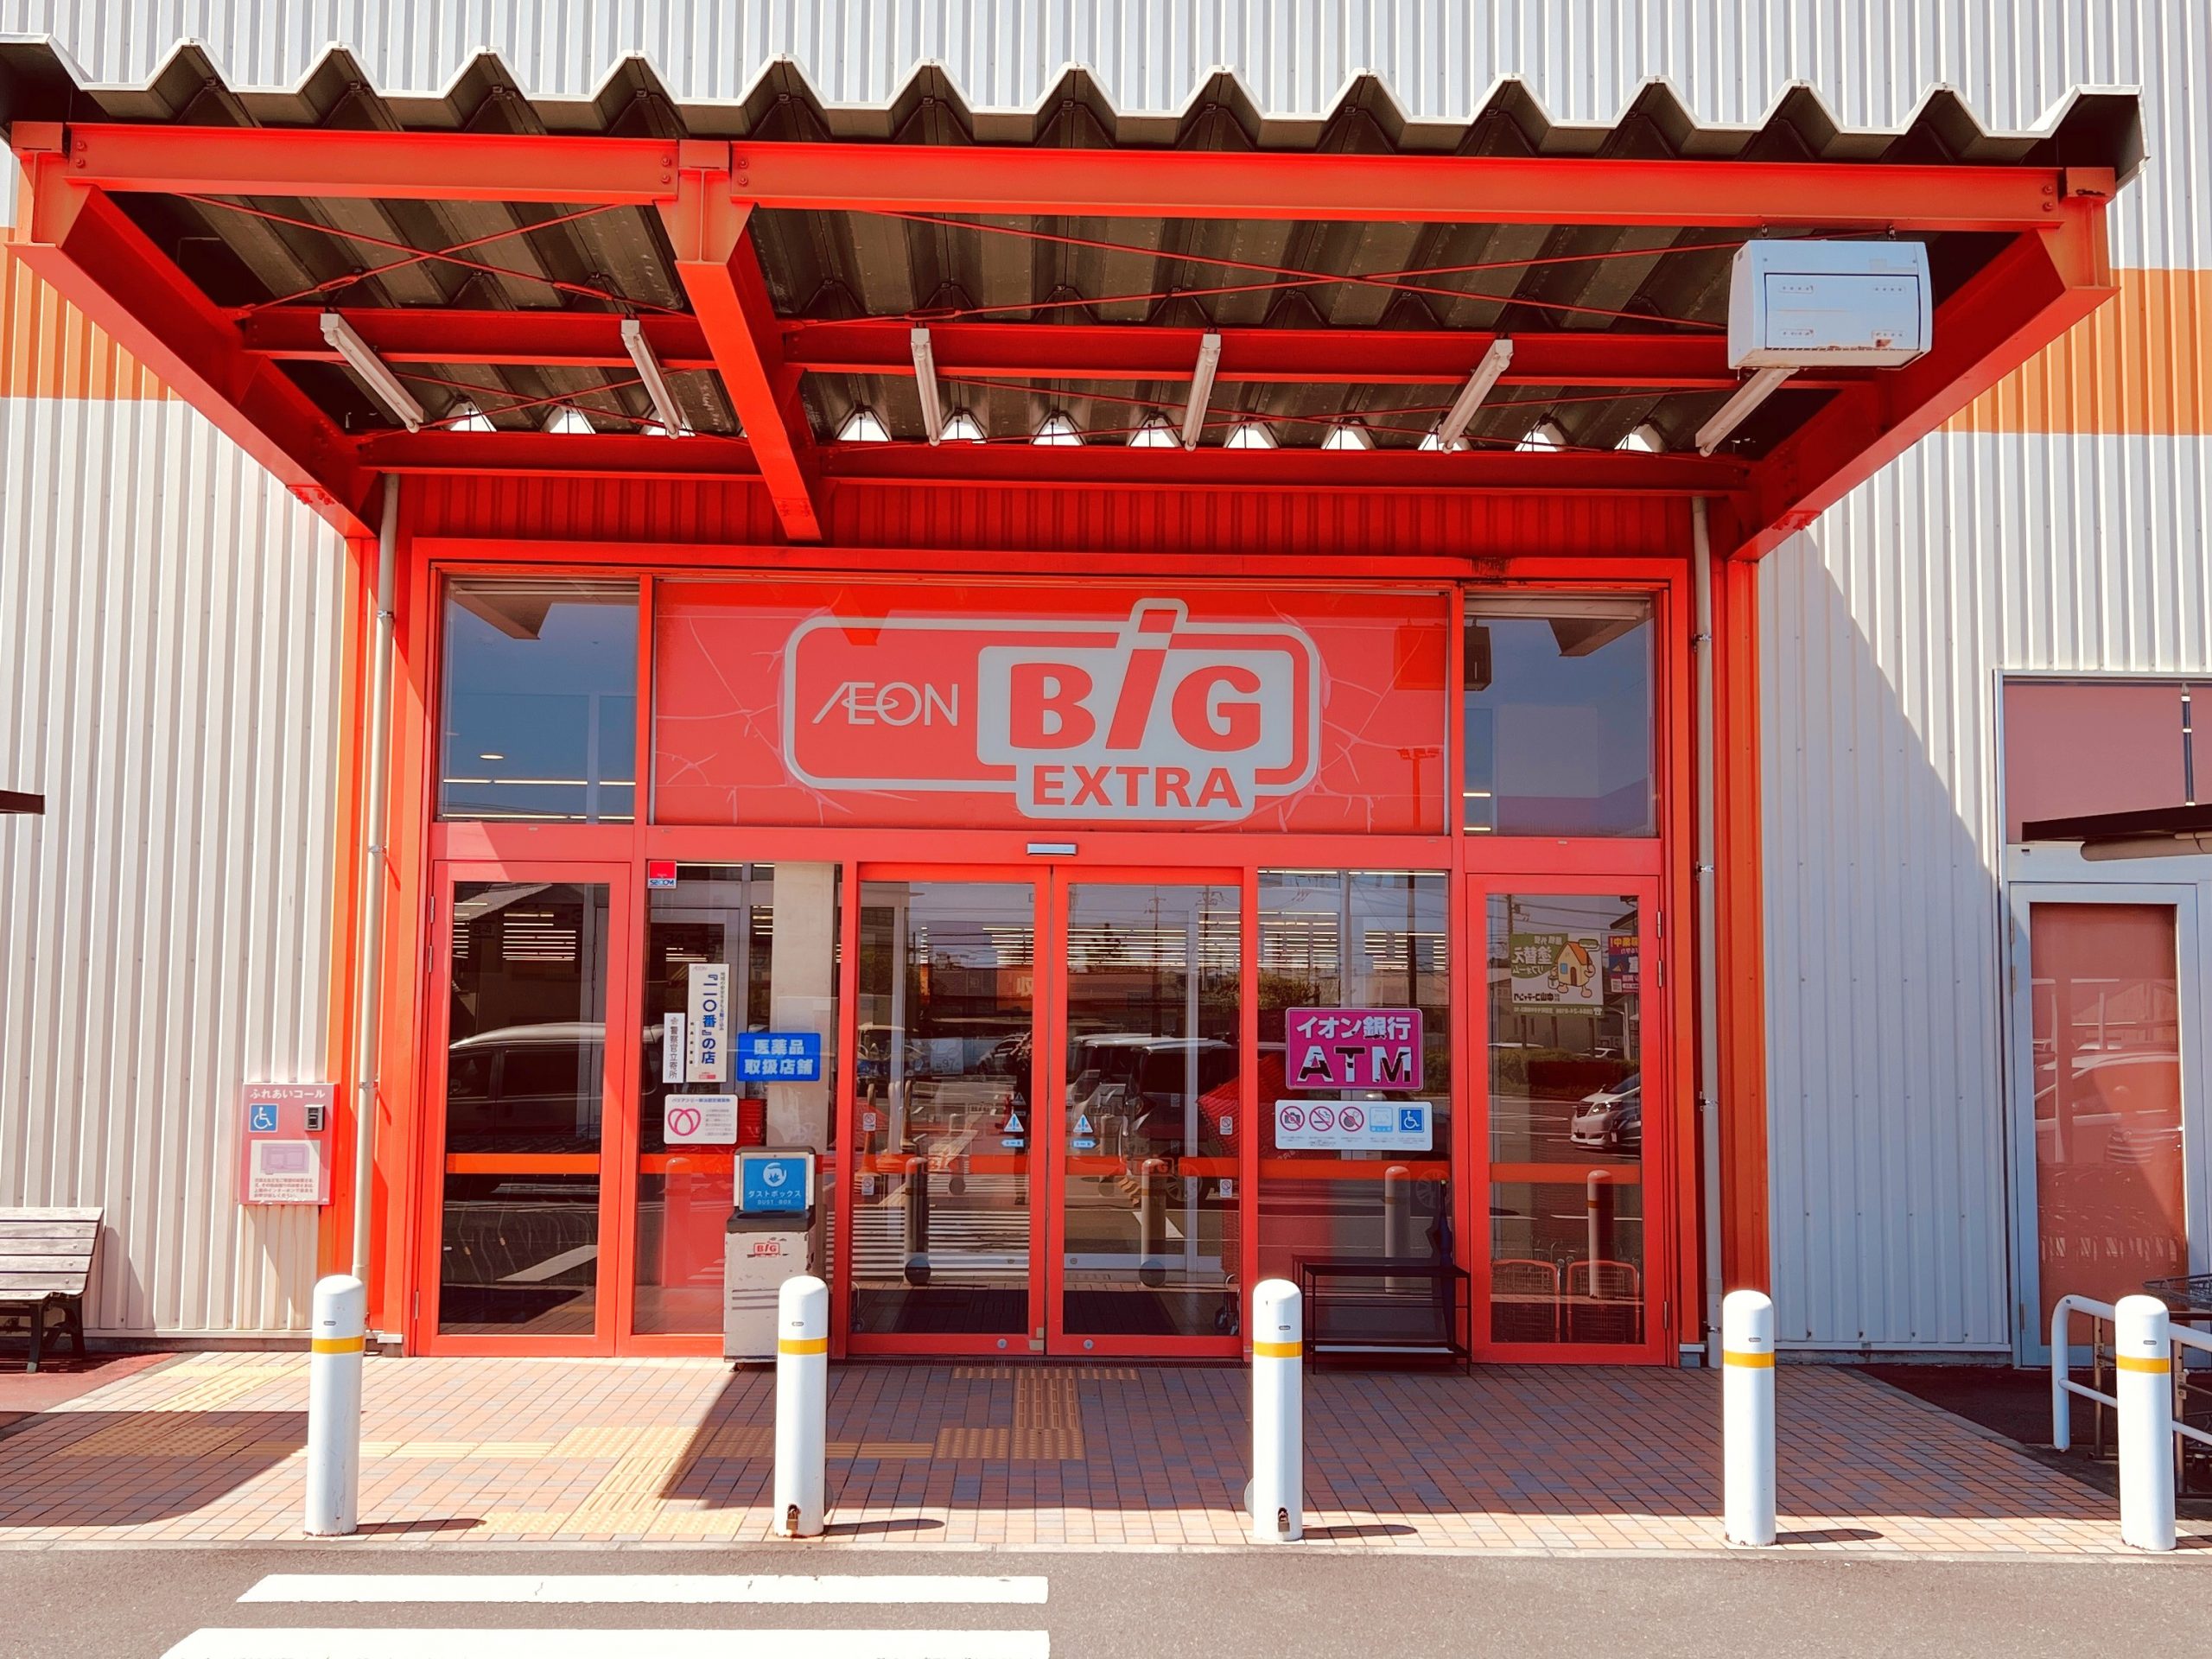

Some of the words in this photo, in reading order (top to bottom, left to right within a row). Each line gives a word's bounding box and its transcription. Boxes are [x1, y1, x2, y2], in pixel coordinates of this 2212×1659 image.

[1033, 766, 1243, 808] EXTRA
[1297, 1015, 1411, 1040] イオン銀行
[753, 1039, 805, 1056] 医薬品
[744, 1058, 813, 1076] 取扱店舗
[1297, 1046, 1413, 1084] ATM
[249, 1089, 326, 1100] ふれあいコール
[748, 1190, 801, 1198] ダストボックス
